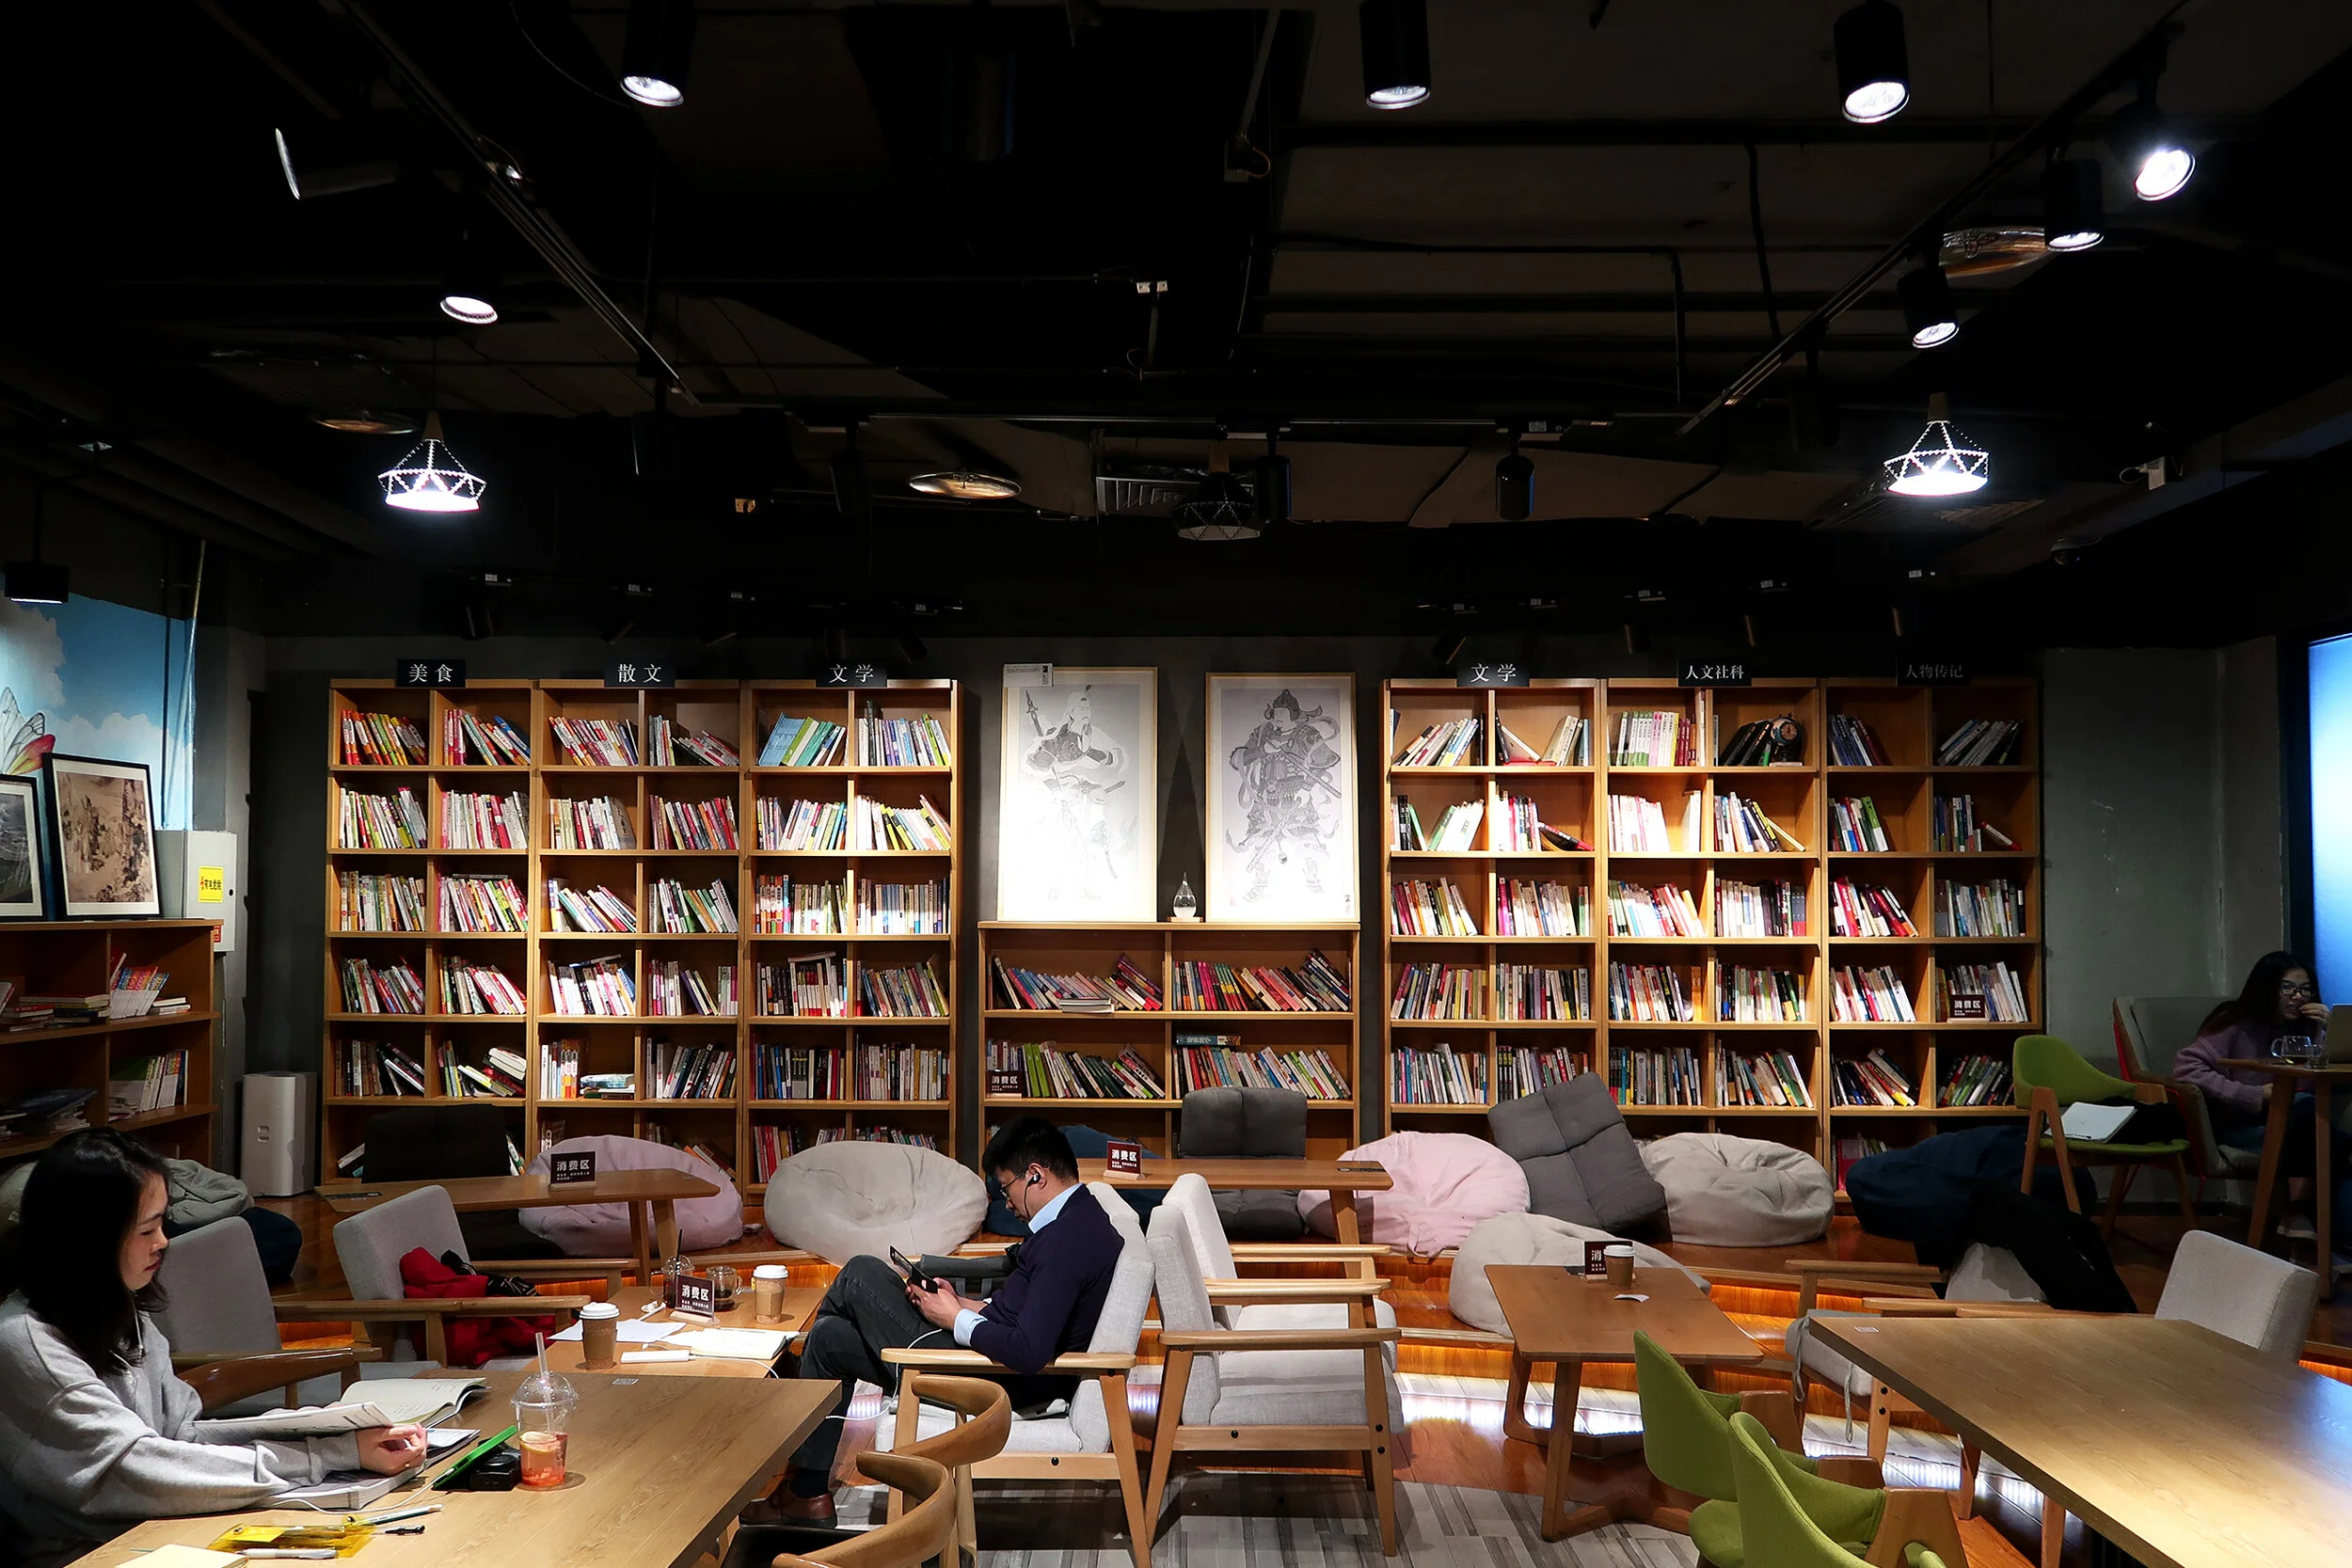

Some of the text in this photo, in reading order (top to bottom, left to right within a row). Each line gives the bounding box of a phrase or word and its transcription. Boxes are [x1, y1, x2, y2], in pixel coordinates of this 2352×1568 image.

[408, 663, 453, 683] 美食
[617, 663, 661, 684] 散文
[828, 663, 874, 684] 文学
[1470, 662, 1517, 683] 文学
[1685, 664, 1744, 680] 人文社科
[1904, 664, 1963, 678] 人物传记
[1111, 1148, 1137, 1162] 消费区
[556, 1159, 590, 1172] 消费区
[681, 1284, 709, 1302] 消费区
